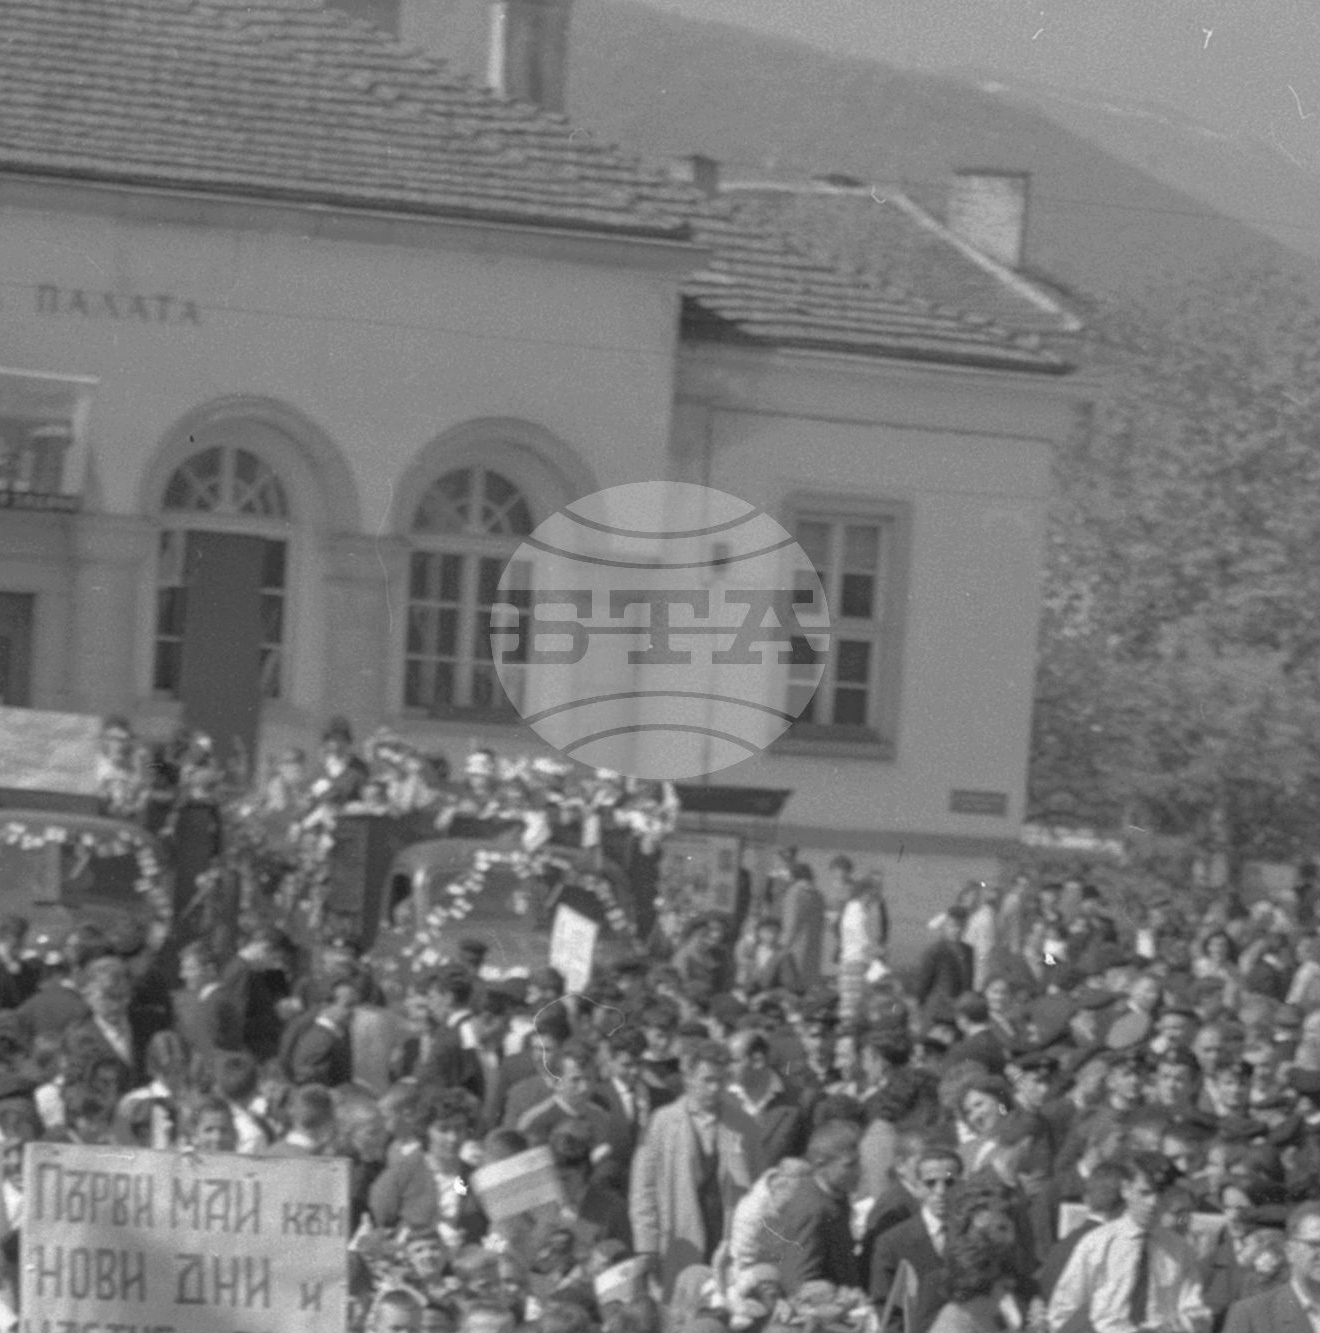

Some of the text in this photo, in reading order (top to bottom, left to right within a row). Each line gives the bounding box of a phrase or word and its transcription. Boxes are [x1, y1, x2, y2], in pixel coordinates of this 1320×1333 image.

[36, 283, 203, 327] ПАЛАТА
[36, 1162, 155, 1228] ПЪРВИ
[171, 1172, 262, 1234] МАЙ
[34, 1245, 147, 1302] НОВИ
[175, 1253, 272, 1309] ДНИ
